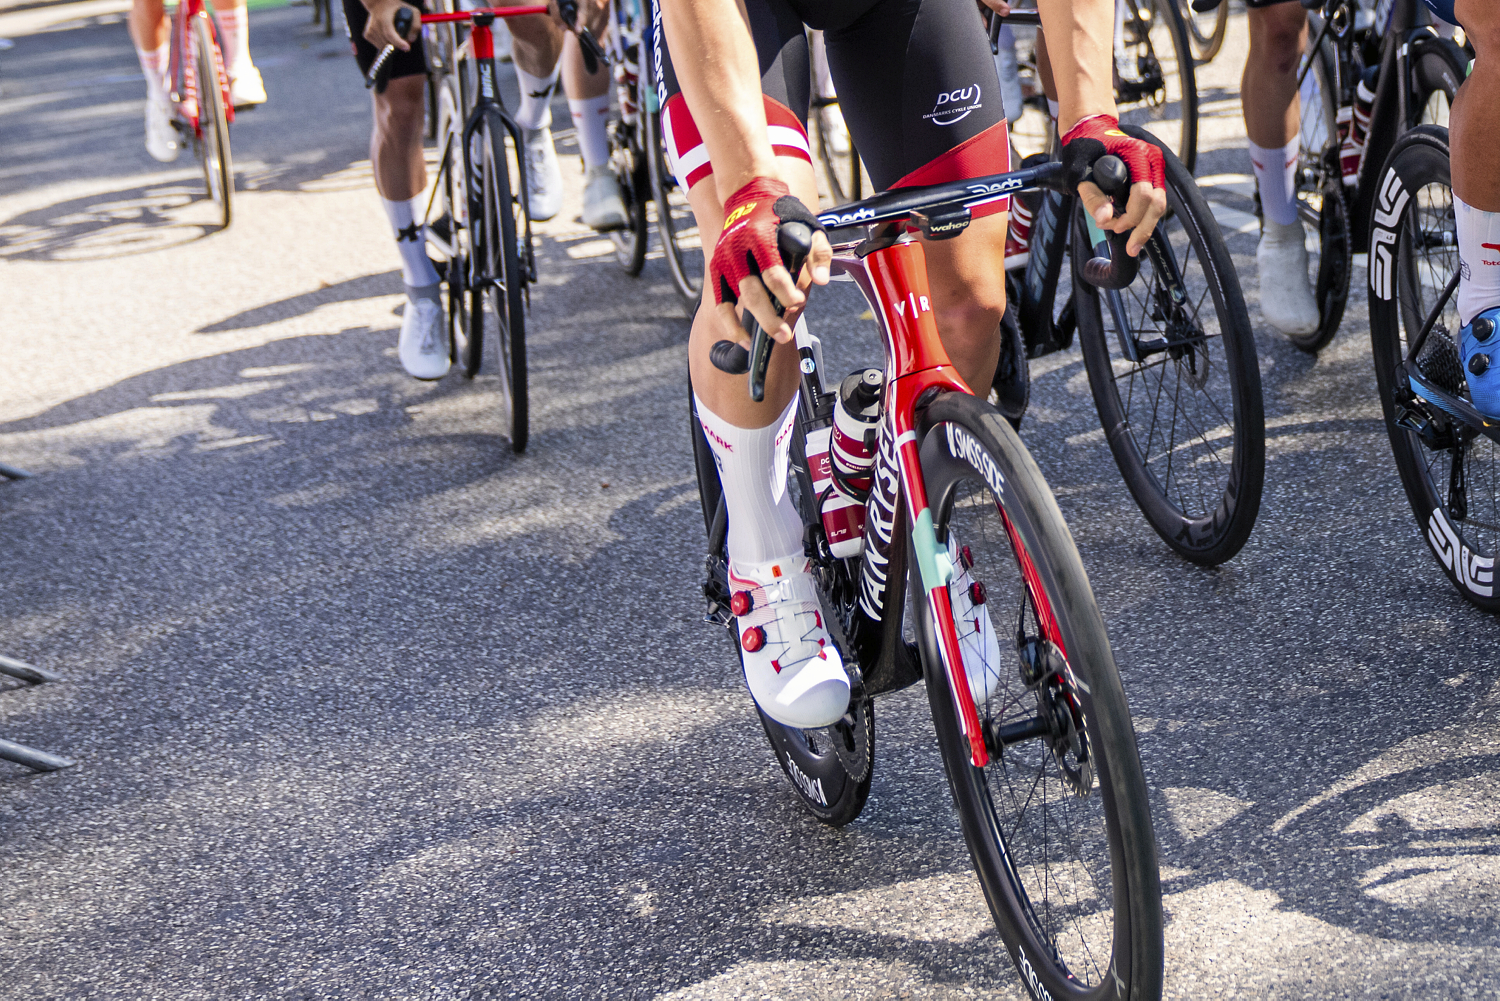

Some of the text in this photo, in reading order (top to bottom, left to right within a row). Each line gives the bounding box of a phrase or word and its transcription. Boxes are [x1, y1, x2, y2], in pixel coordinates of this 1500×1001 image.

[936, 86, 973, 105] DCU
[930, 220, 969, 233] wahoo
[859, 532, 890, 622] VAN
